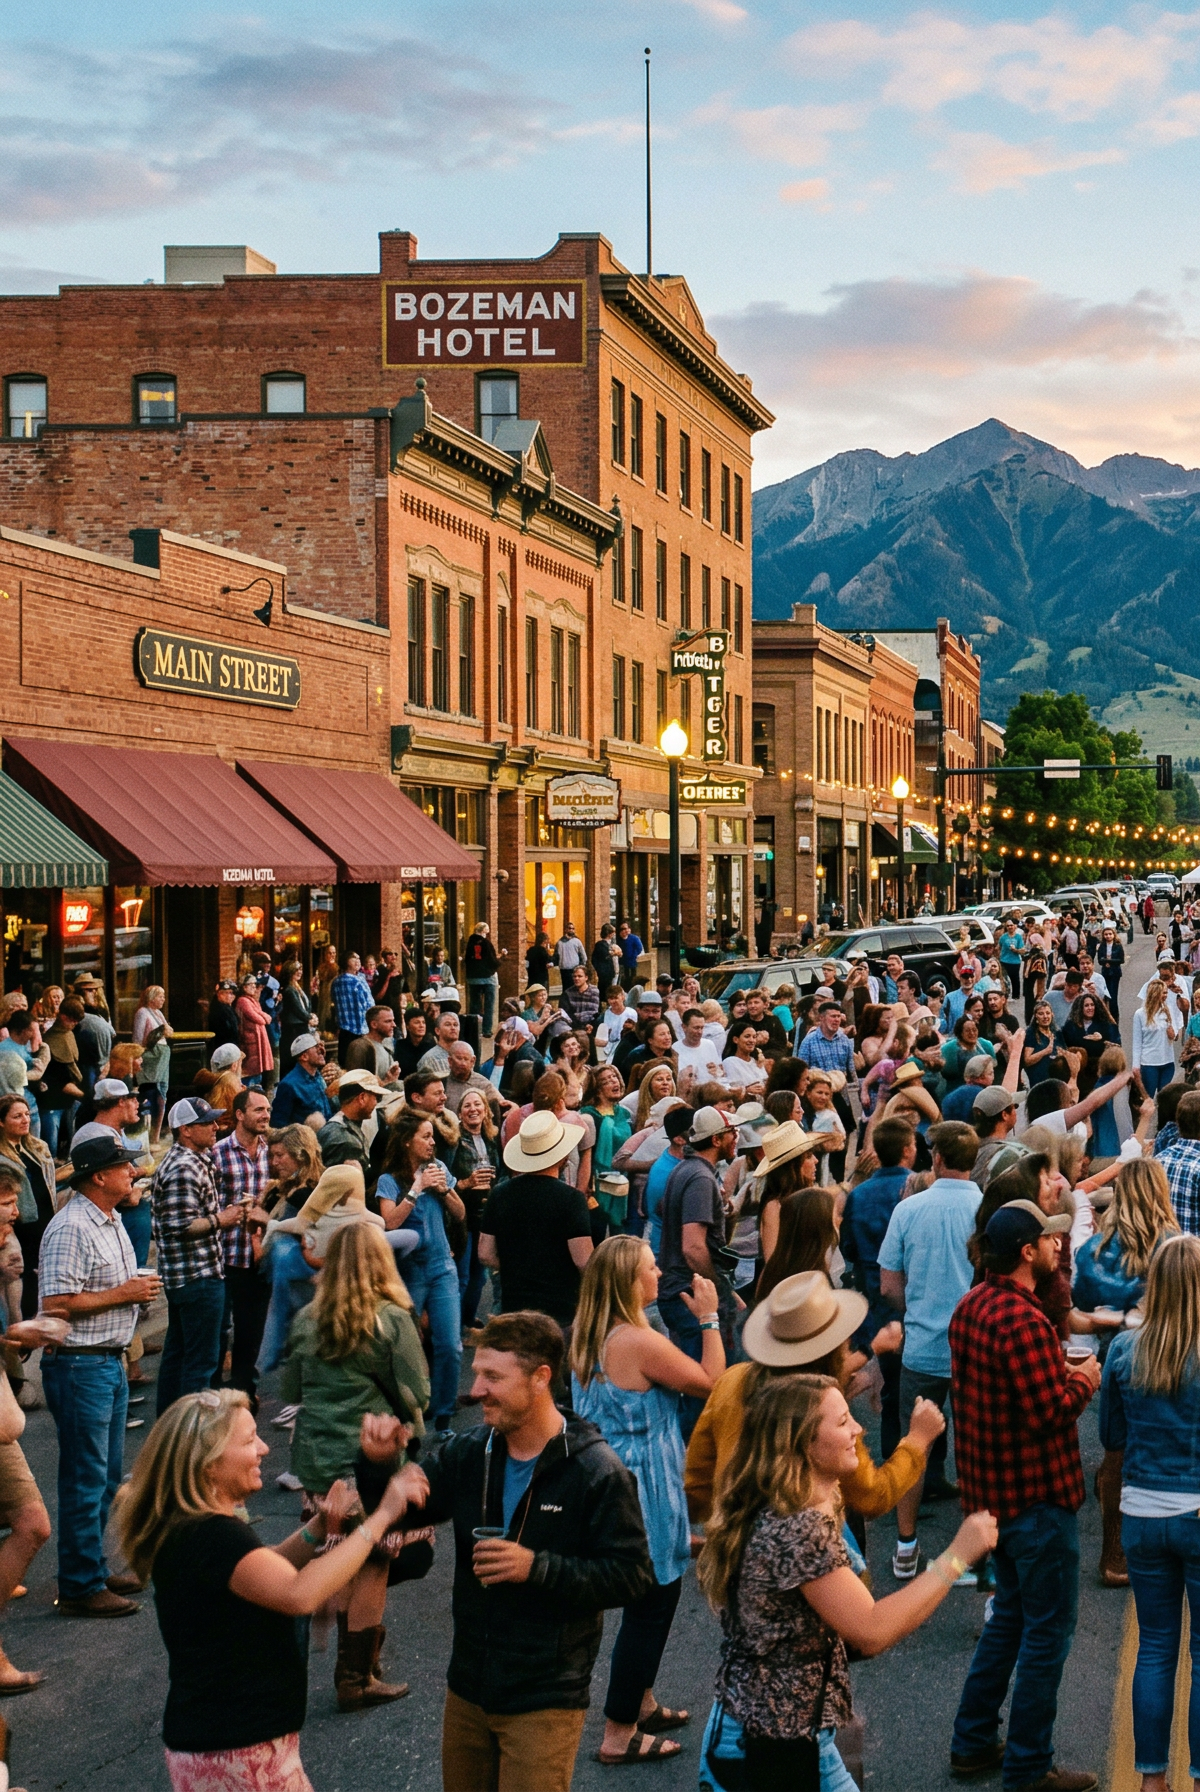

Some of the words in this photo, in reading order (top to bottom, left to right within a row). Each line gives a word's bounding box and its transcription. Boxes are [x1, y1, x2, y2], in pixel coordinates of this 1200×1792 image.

[395, 292, 575, 320] BOZEMAN
[417, 328, 556, 357] HOTEL
[153, 641, 213, 684] MAIN
[219, 654, 292, 697] STREET
